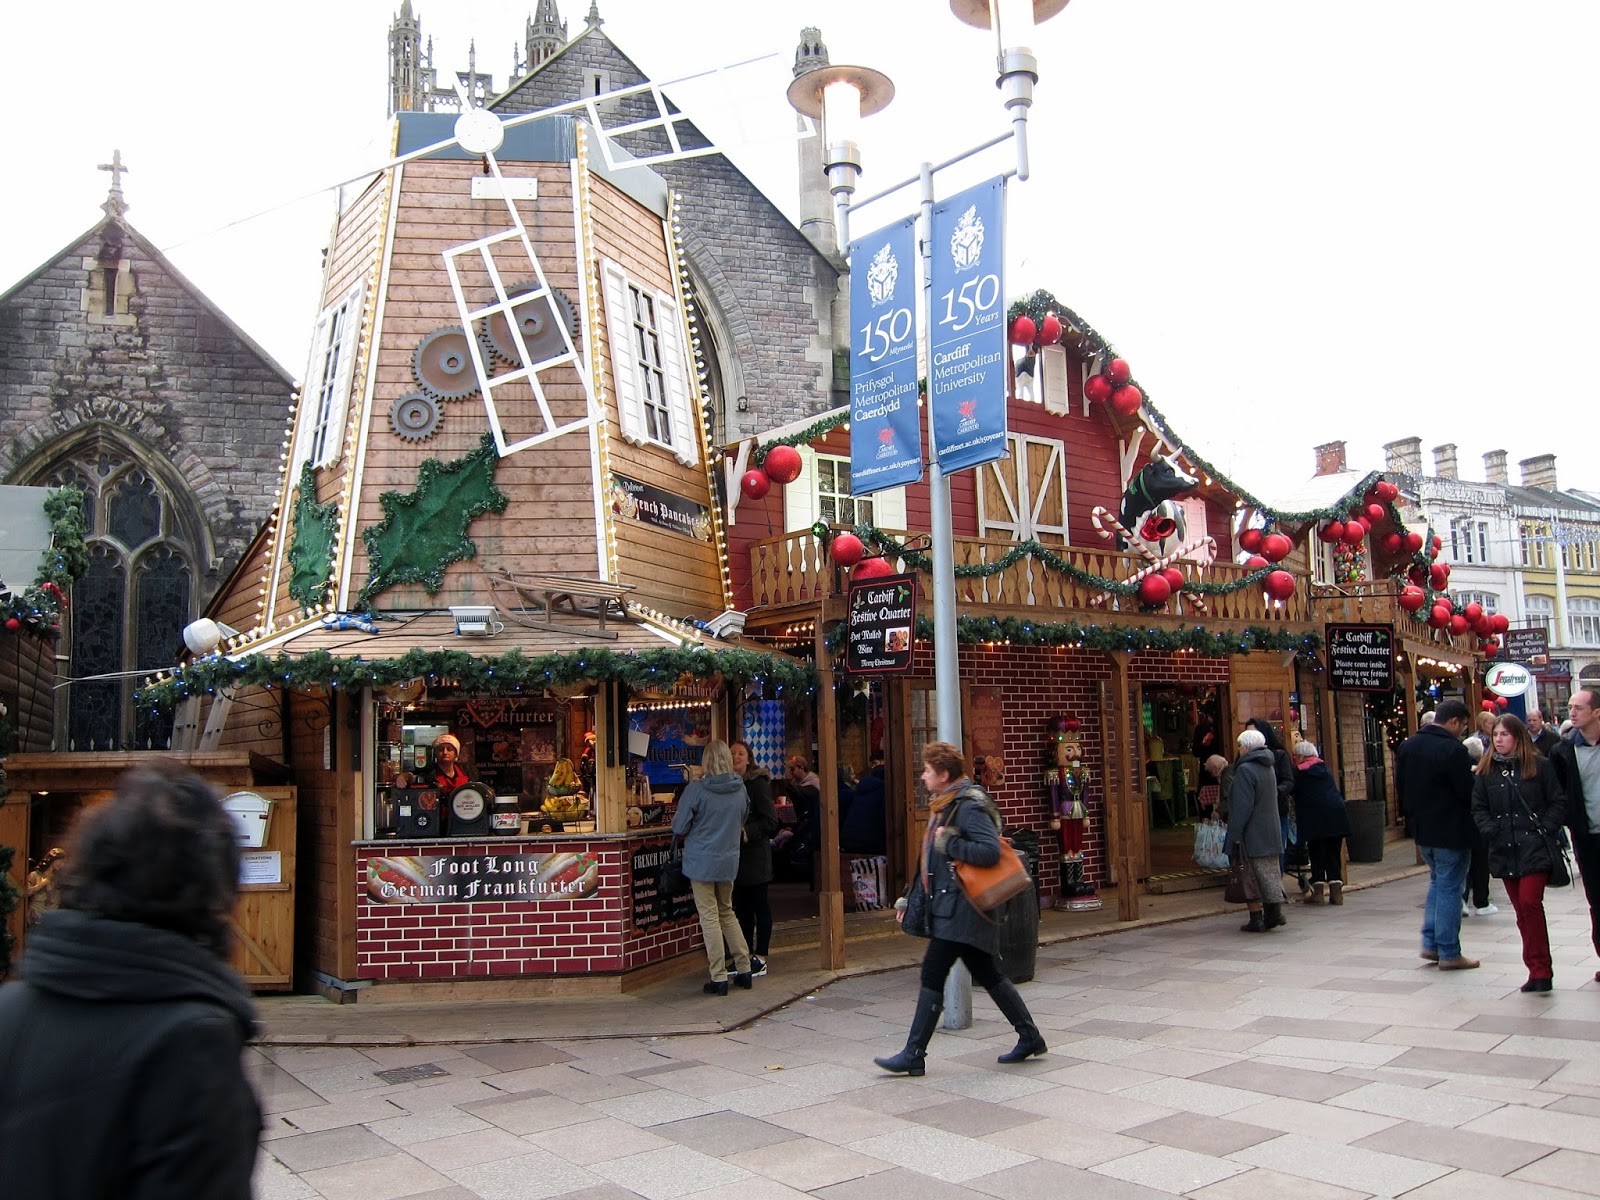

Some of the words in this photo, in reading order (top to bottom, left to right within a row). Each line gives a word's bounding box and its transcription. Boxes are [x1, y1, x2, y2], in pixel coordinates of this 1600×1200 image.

[939, 274, 999, 330] 150
[975, 311, 999, 325] Years
[858, 308, 912, 361] 150
[933, 343, 971, 366] Cardiff
[935, 351, 1001, 380] Metropolitan
[855, 371, 894, 394] Prifysgol
[935, 371, 986, 395] University
[855, 381, 915, 408] Metropolitan
[854, 398, 900, 421] Caerdydd
[626, 493, 659, 517] French
[660, 502, 700, 528] Pancakes
[867, 588, 895, 605] Cardiff
[851, 609, 878, 626] Festive
[879, 606, 911, 620] Quarter
[1345, 632, 1373, 644] Cardiff
[1330, 644, 1357, 656] Festive
[1358, 644, 1390, 655] Quarter
[1335, 659, 1353, 668] Please
[1344, 669, 1359, 678] enjoy
[1370, 669, 1389, 677] festive
[1342, 677, 1354, 685] food
[1361, 678, 1380, 686] Drink
[428, 857, 480, 878] Foot
[484, 856, 539, 876] Long
[634, 851, 658, 869] FRENCH
[380, 881, 458, 898] German
[463, 879, 586, 900] Frankfurter
